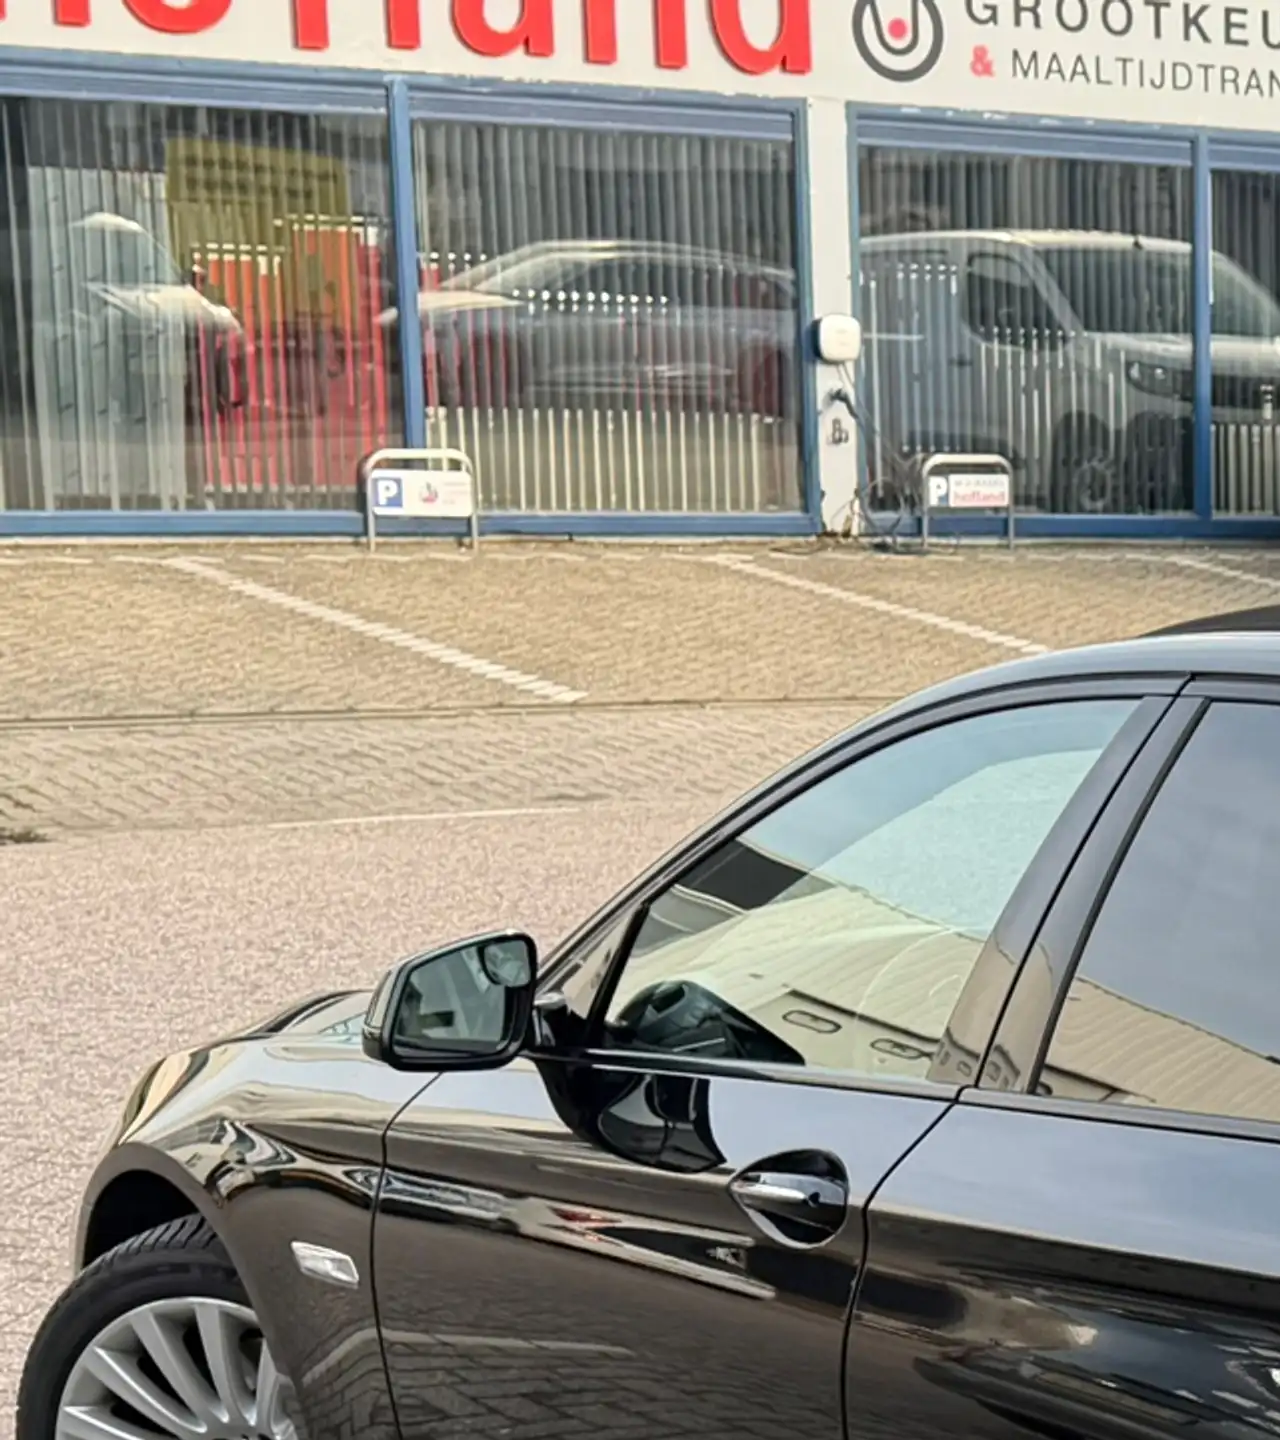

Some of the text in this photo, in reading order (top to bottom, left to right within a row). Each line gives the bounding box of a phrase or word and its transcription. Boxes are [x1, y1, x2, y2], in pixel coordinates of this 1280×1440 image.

[970, 45, 995, 77] &
[378, 480, 418, 505] P
[929, 476, 948, 506] P
